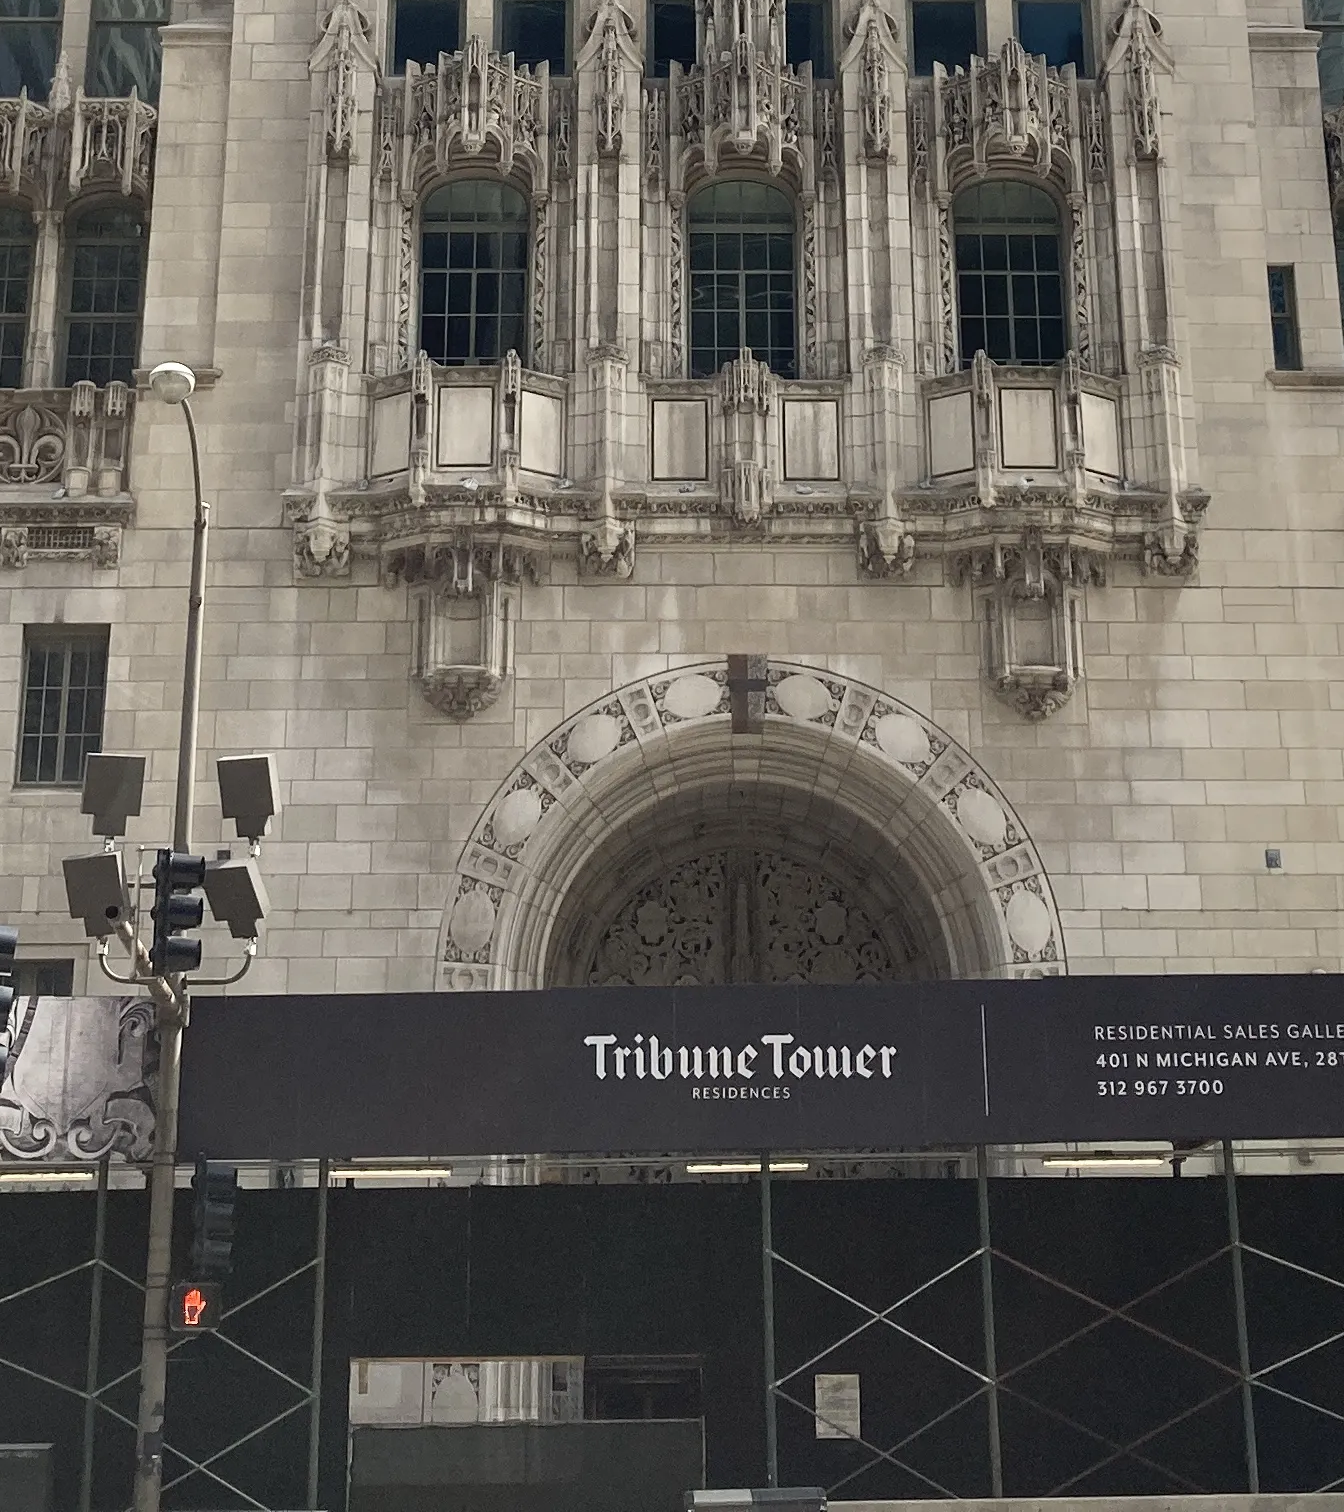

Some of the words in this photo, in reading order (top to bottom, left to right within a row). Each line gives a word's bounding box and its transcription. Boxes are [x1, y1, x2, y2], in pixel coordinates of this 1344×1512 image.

[1094, 1024, 1217, 1041] RESIDENTIAL
[1223, 1024, 1280, 1040] SALES
[583, 1033, 759, 1080] Tribune
[760, 1032, 897, 1079] Tower
[1095, 1052, 1129, 1068] 401
[1136, 1053, 1149, 1068] N
[1156, 1051, 1258, 1068] MICHIGAN
[1265, 1051, 1309, 1069] AVE,
[692, 1086, 791, 1100] RESIDENCES
[1097, 1080, 1127, 1096] 312
[1134, 1080, 1169, 1096] 967
[1175, 1079, 1224, 1095] 3700
